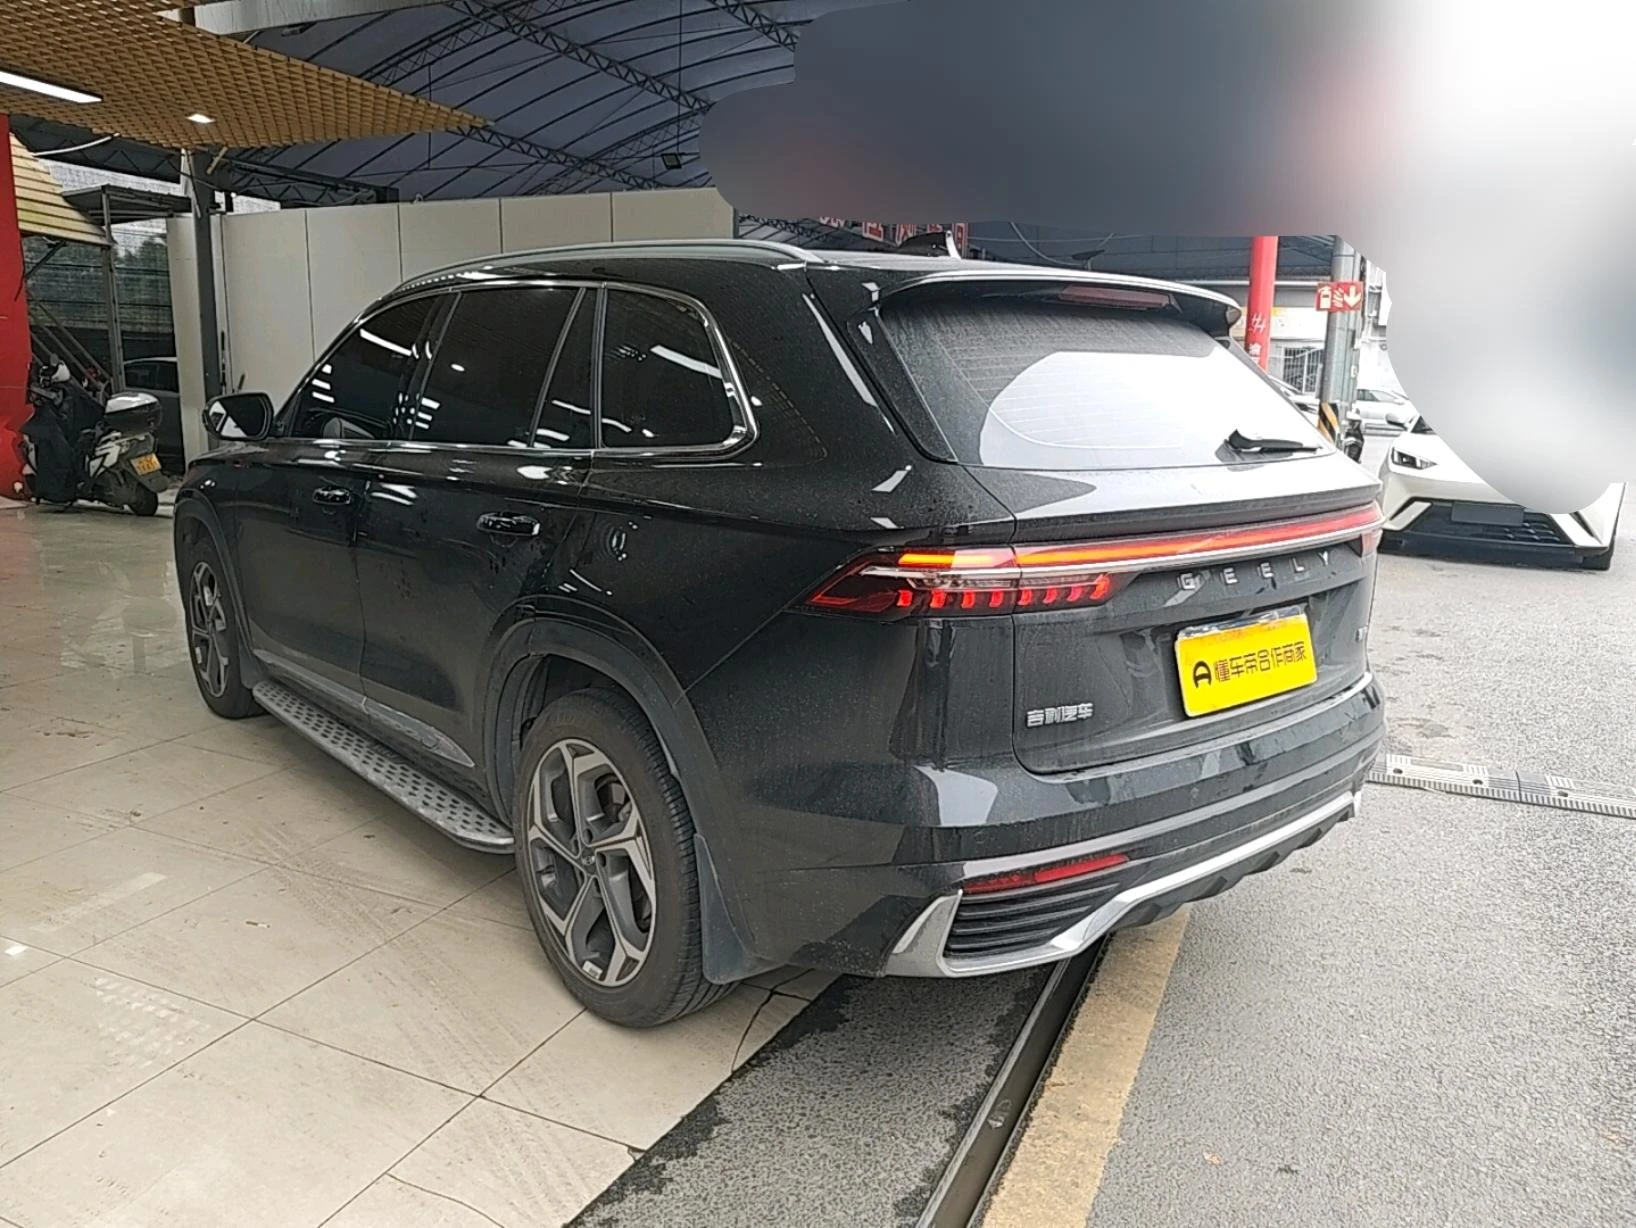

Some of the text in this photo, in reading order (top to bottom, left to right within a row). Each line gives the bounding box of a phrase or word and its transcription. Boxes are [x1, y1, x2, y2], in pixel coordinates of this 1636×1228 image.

[1177, 551, 1329, 590] GEELY
[1214, 641, 1307, 682] 懂车帝合作商家
[1027, 703, 1093, 727] 吉利汽车
